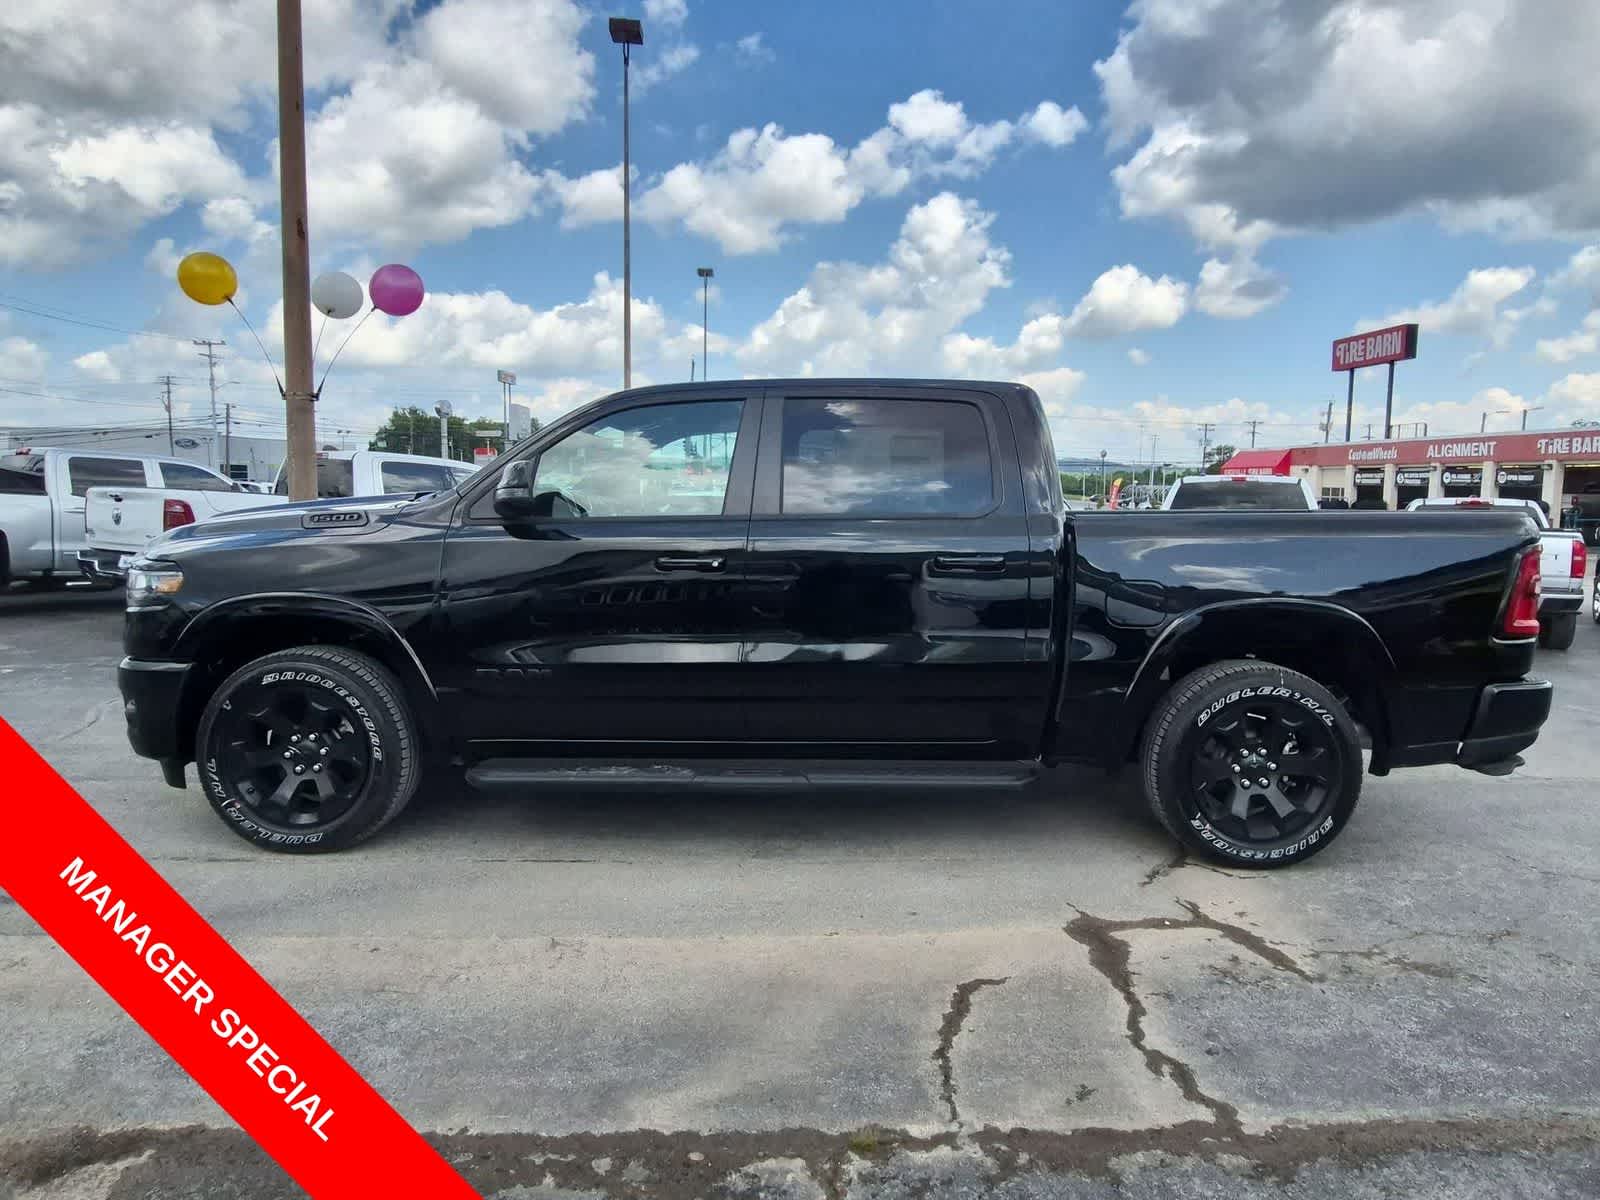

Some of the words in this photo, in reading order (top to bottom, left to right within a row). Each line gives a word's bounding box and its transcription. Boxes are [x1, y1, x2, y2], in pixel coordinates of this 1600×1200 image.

[1366, 330, 1402, 360] BARN
[1426, 441, 1496, 458] ALIGNMENT
[310, 511, 363, 523] 1500
